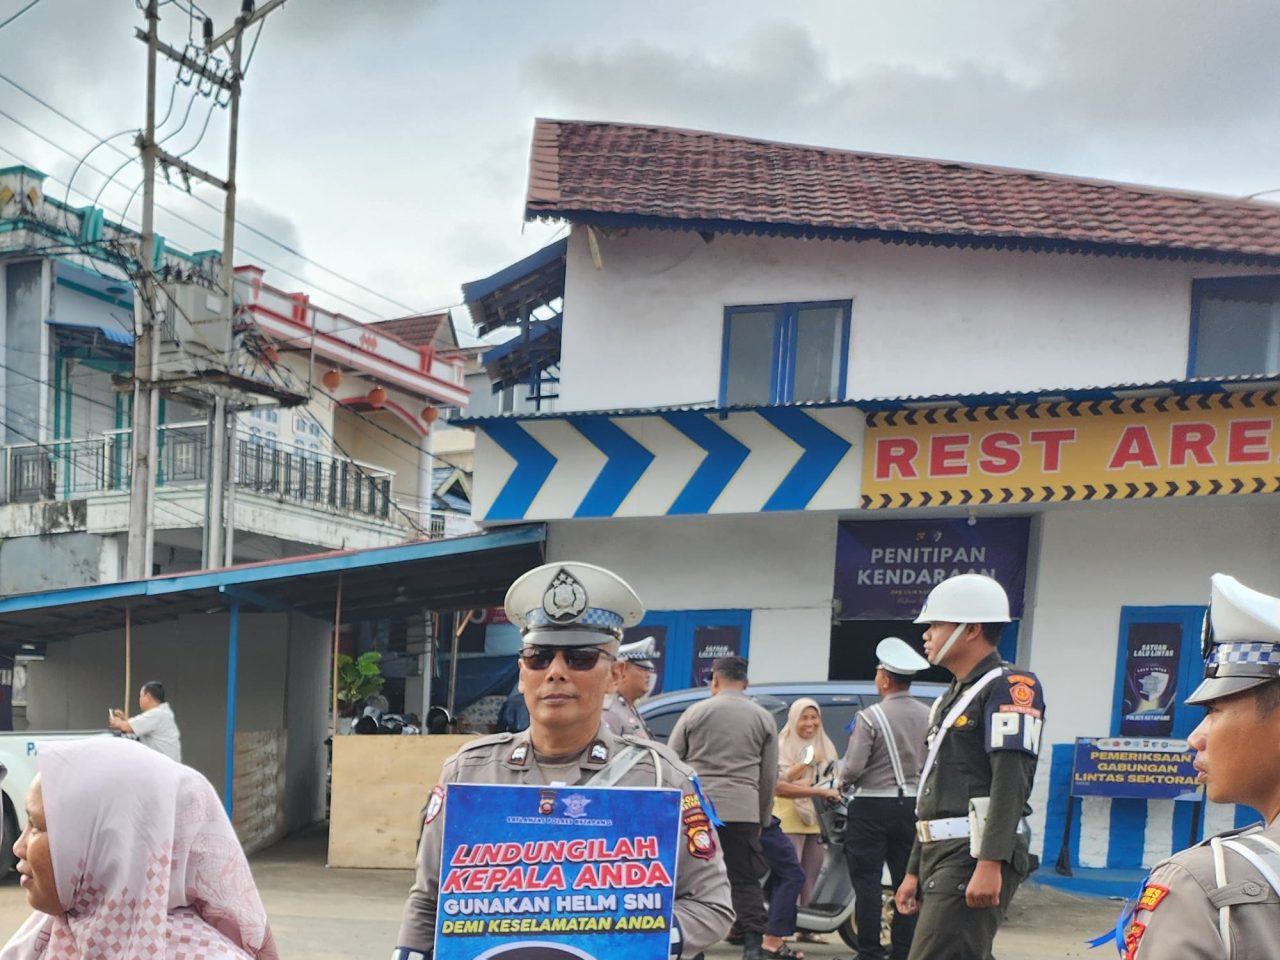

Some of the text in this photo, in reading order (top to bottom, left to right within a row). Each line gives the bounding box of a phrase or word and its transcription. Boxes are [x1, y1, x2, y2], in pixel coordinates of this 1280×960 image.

[873, 417, 1280, 482] REST ARE
[870, 547, 986, 564] PENITIPAN
[1090, 752, 1192, 763] PEMERIKSAAN
[1097, 763, 1178, 773] GABUNGAN
[1075, 773, 1203, 785] LINTAS SEKTORAL
[450, 835, 659, 867] LINDUNGILAH
[441, 862, 671, 894] KEPALA ANDA
[443, 892, 662, 916] GUNAKAN HELM SNI
[441, 915, 666, 935] DEMI KESELAMATAN ANDA
